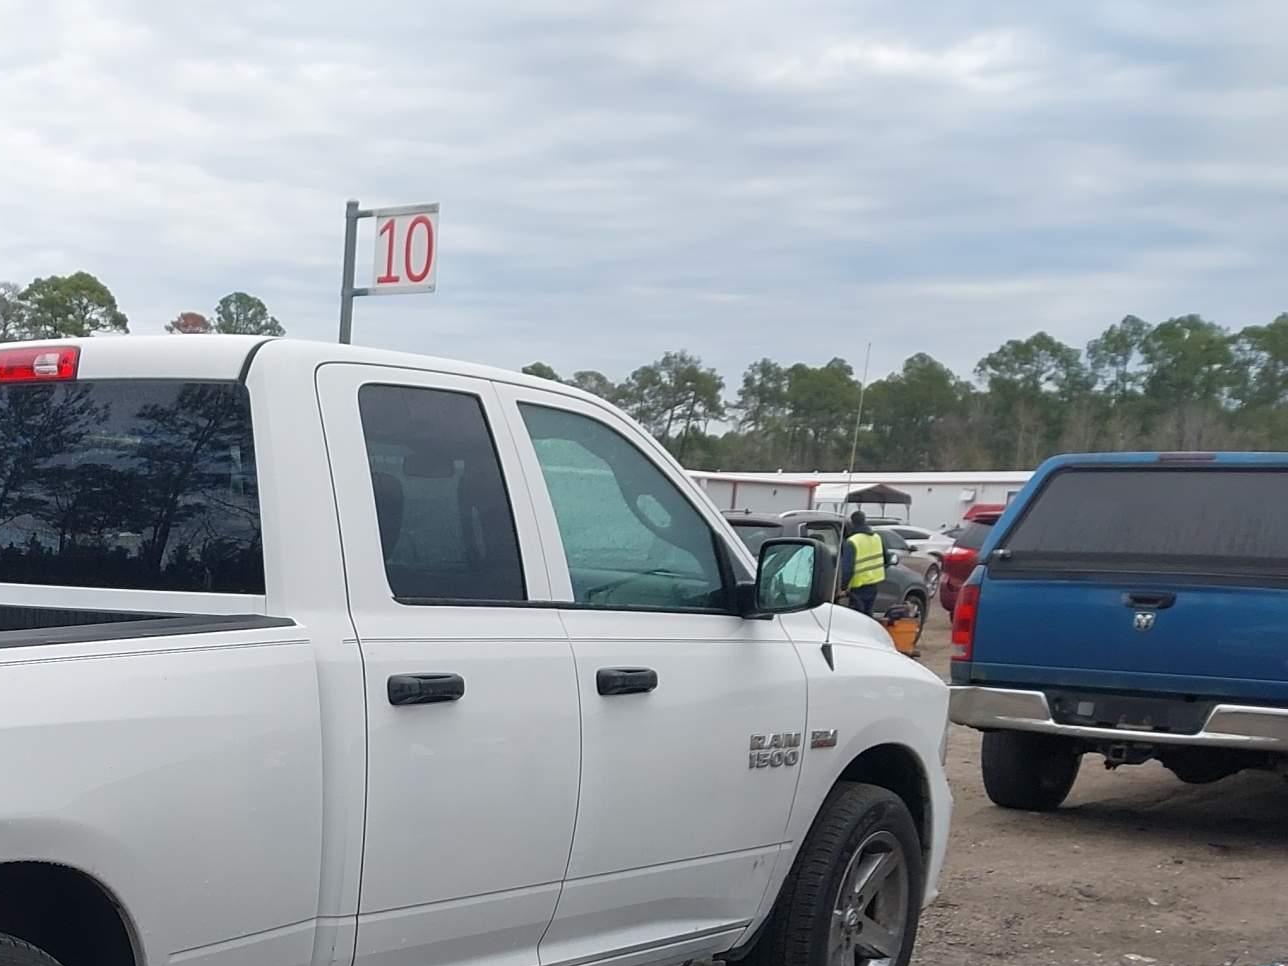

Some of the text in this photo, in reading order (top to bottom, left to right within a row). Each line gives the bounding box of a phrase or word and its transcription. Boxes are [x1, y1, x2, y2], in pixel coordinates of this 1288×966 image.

[377, 215, 434, 283] 10
[750, 733, 801, 750] RAM
[749, 750, 800, 768] 1500
